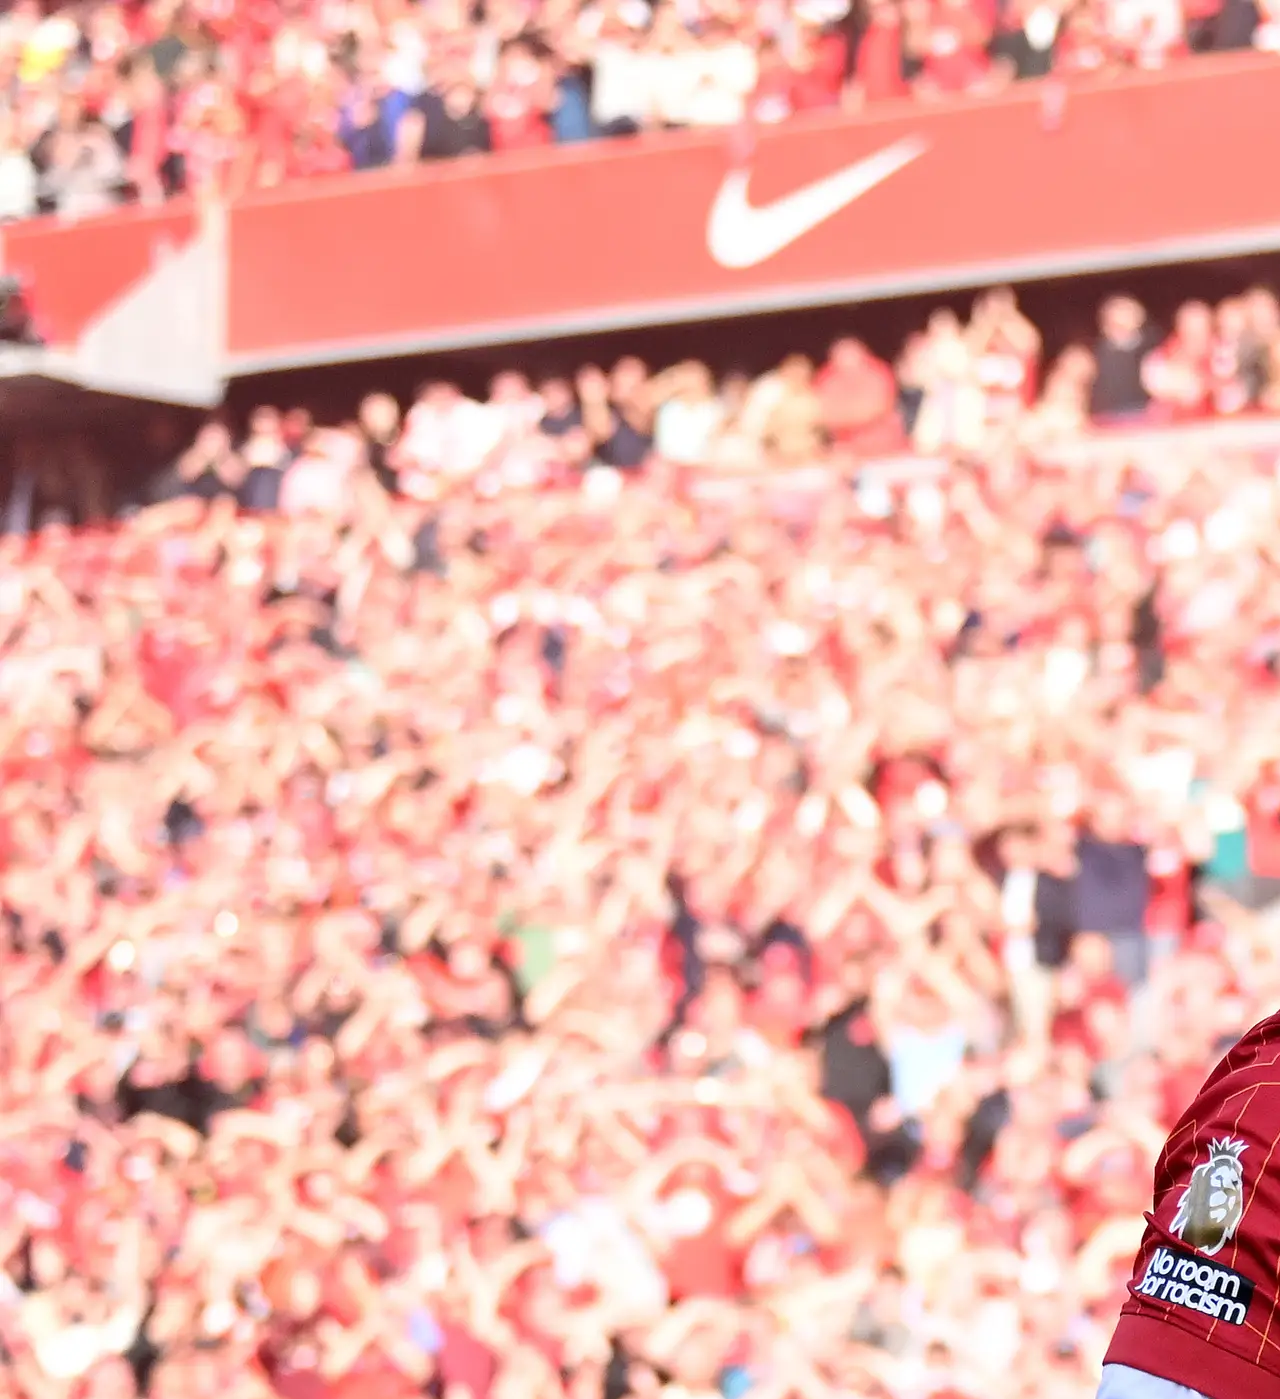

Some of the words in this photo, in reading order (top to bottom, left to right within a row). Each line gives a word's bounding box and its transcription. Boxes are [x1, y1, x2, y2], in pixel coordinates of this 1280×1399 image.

[1134, 1270, 1167, 1296] for
[1160, 1281, 1248, 1325] racism
[1150, 1247, 1175, 1275] No
[1172, 1257, 1241, 1298] room
